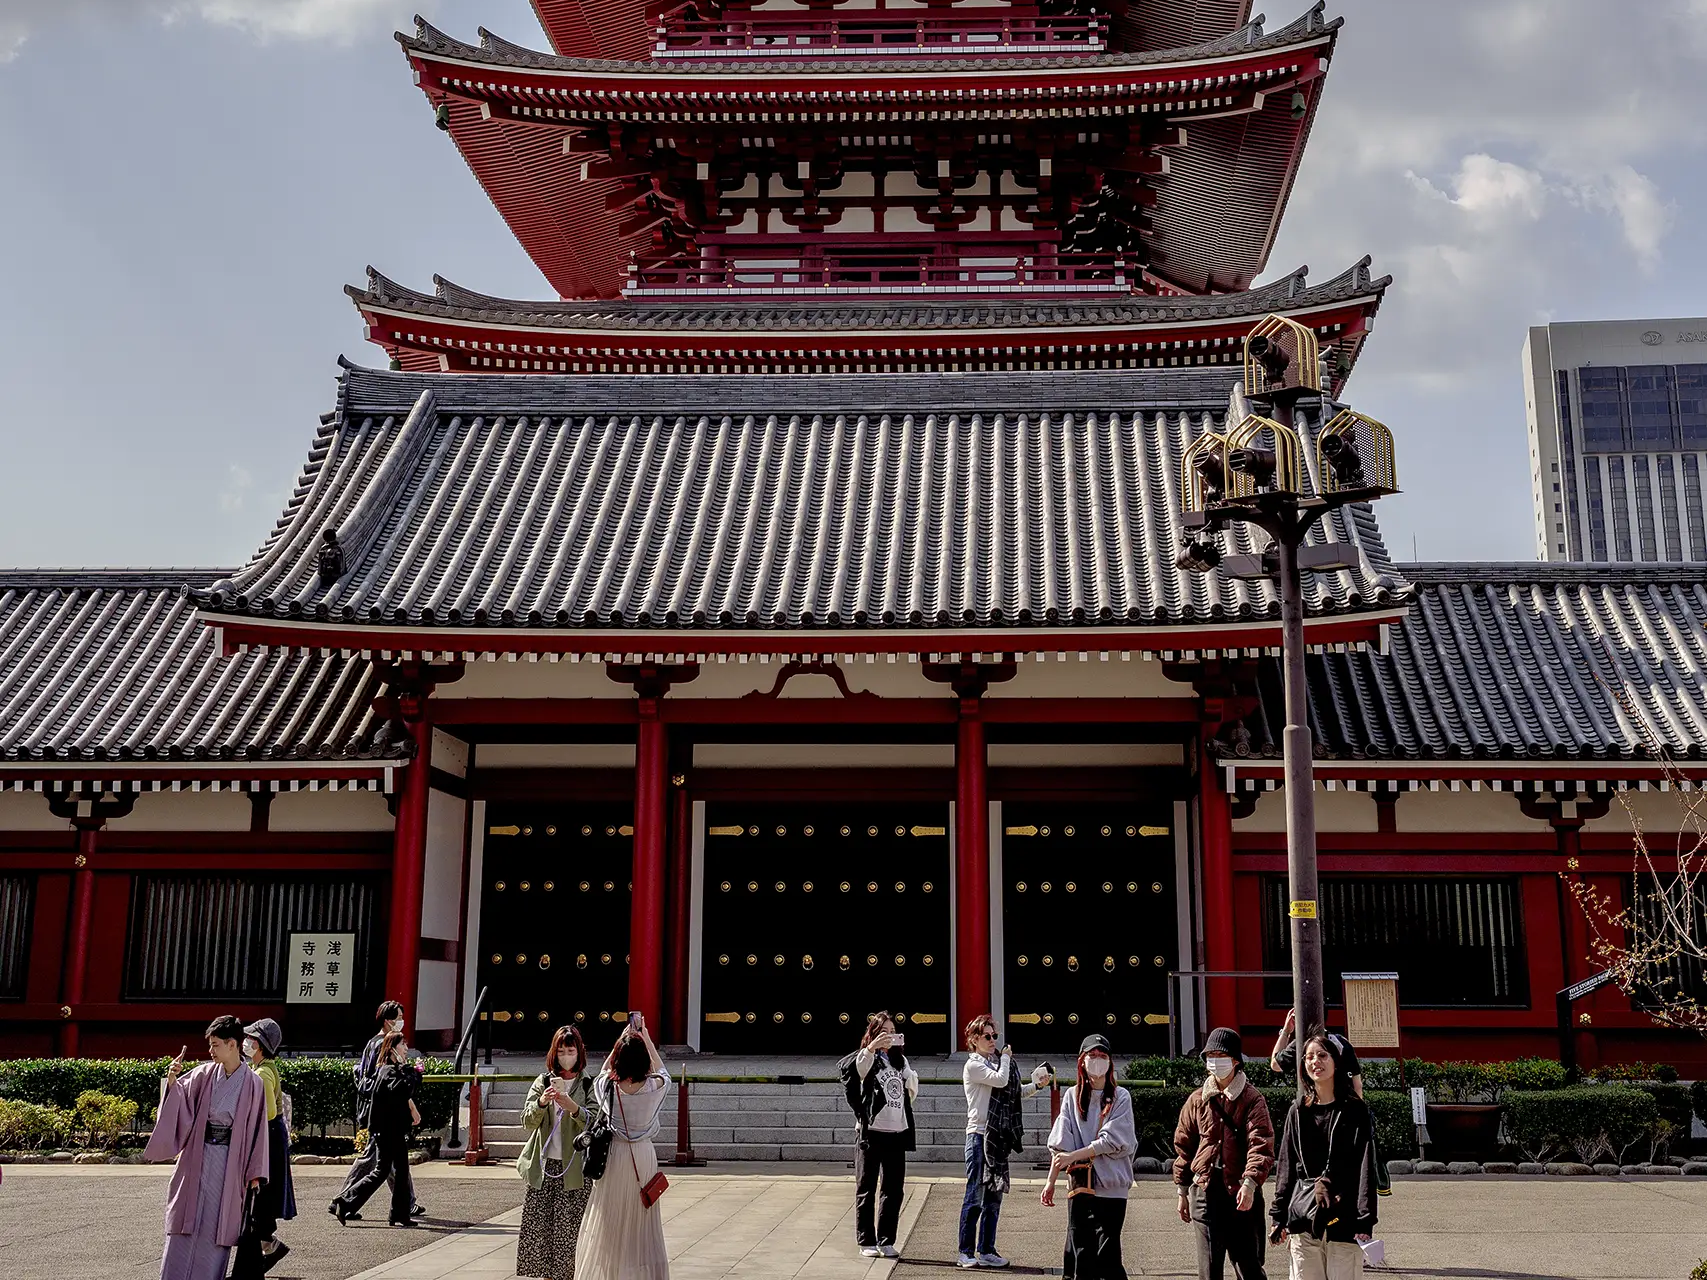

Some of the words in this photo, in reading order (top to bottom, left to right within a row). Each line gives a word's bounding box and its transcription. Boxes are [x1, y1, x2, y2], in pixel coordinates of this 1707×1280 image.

[299, 940, 316, 996] 寺務所
[326, 940, 342, 996] 浅草寺
